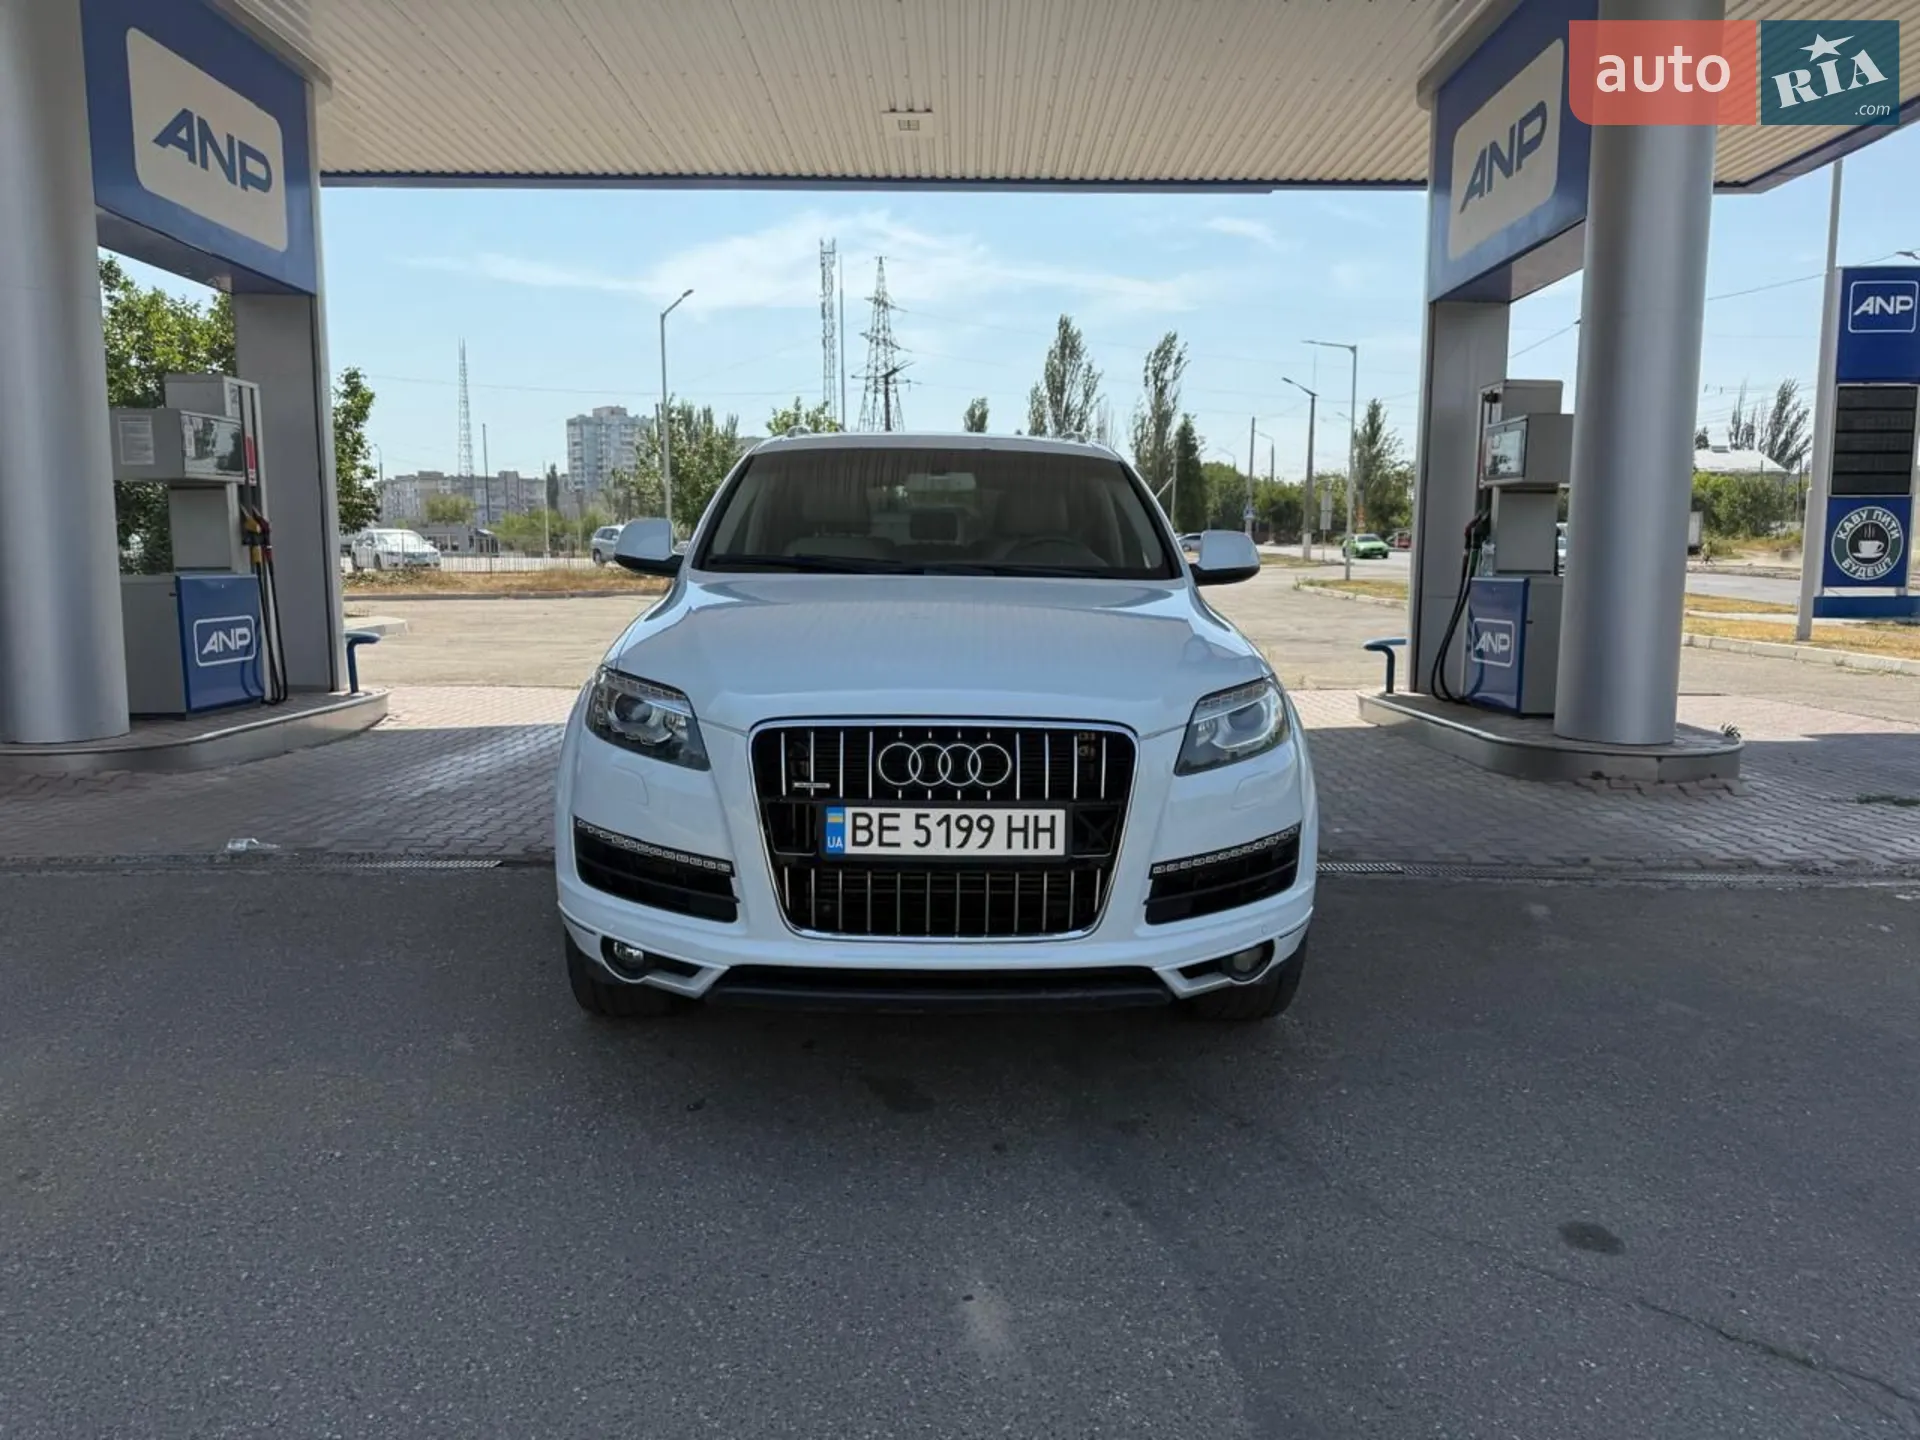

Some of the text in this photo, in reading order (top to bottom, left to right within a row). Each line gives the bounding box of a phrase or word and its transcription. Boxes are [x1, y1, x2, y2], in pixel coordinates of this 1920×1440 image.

[153, 107, 273, 194] ANP
[1459, 100, 1548, 214] ANP
[1853, 295, 1914, 316] ANP
[1837, 509, 1900, 540] КАВУ ПИТИ
[1841, 557, 1893, 579] БУДЕШ?
[202, 627, 251, 655] ANP
[1475, 631, 1511, 655] ANP
[827, 836, 843, 848] UA
[851, 812, 1056, 849] BE 5199 HH
